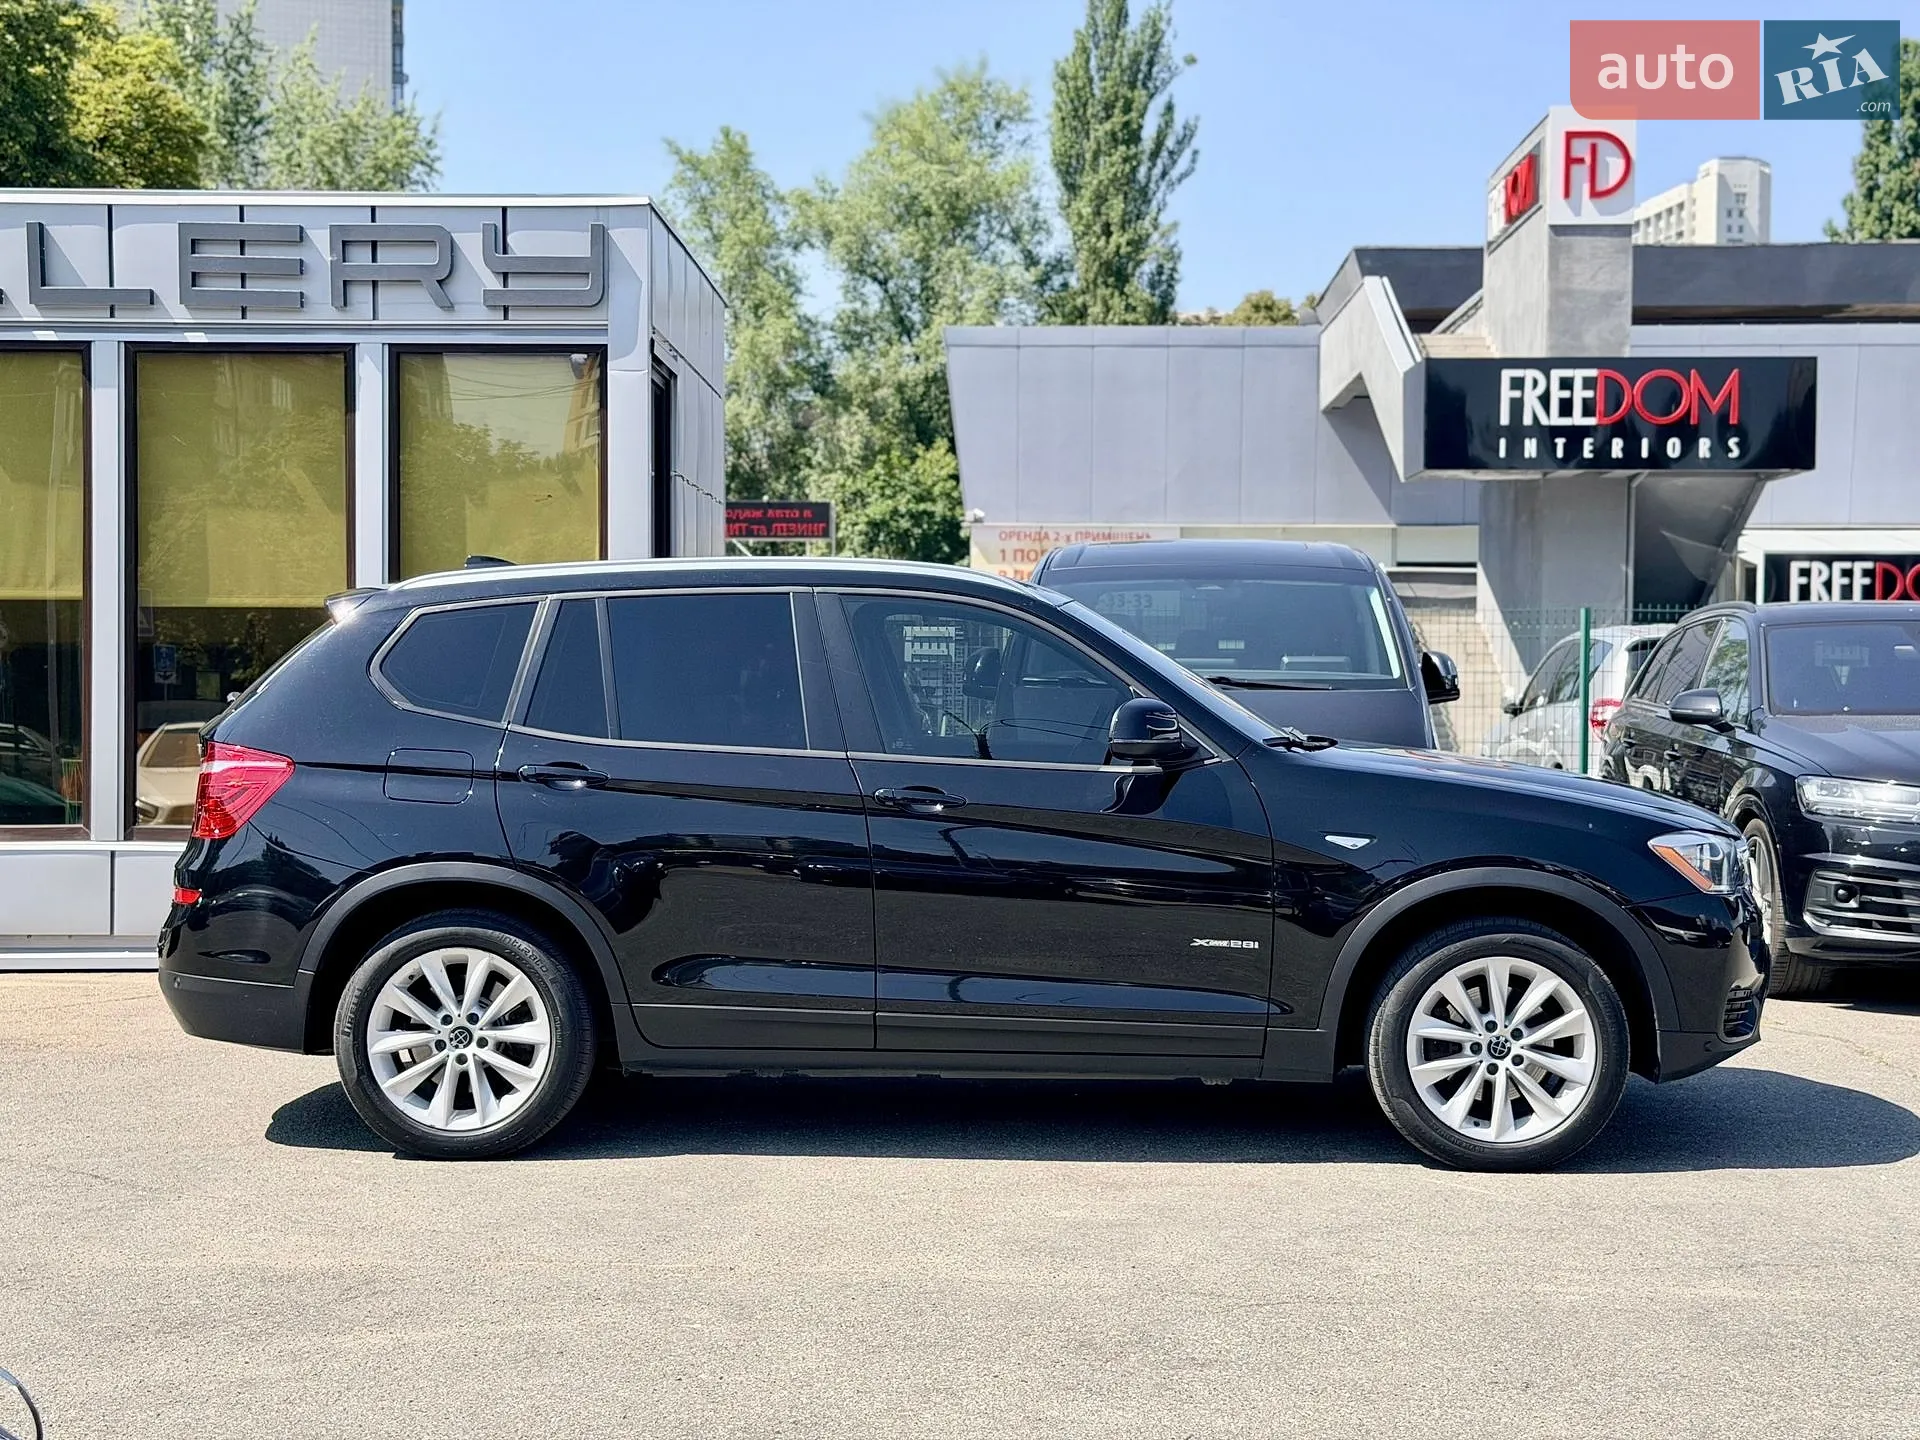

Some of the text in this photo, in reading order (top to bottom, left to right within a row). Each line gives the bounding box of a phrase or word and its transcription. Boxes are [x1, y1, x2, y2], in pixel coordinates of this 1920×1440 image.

[1564, 131, 1632, 199] FD
[0, 221, 605, 310] LERY
[1499, 368, 1740, 426] FREEDOM
[1499, 437, 1741, 459] INTERIORS
[999, 530, 1050, 541] ОРЕНДА
